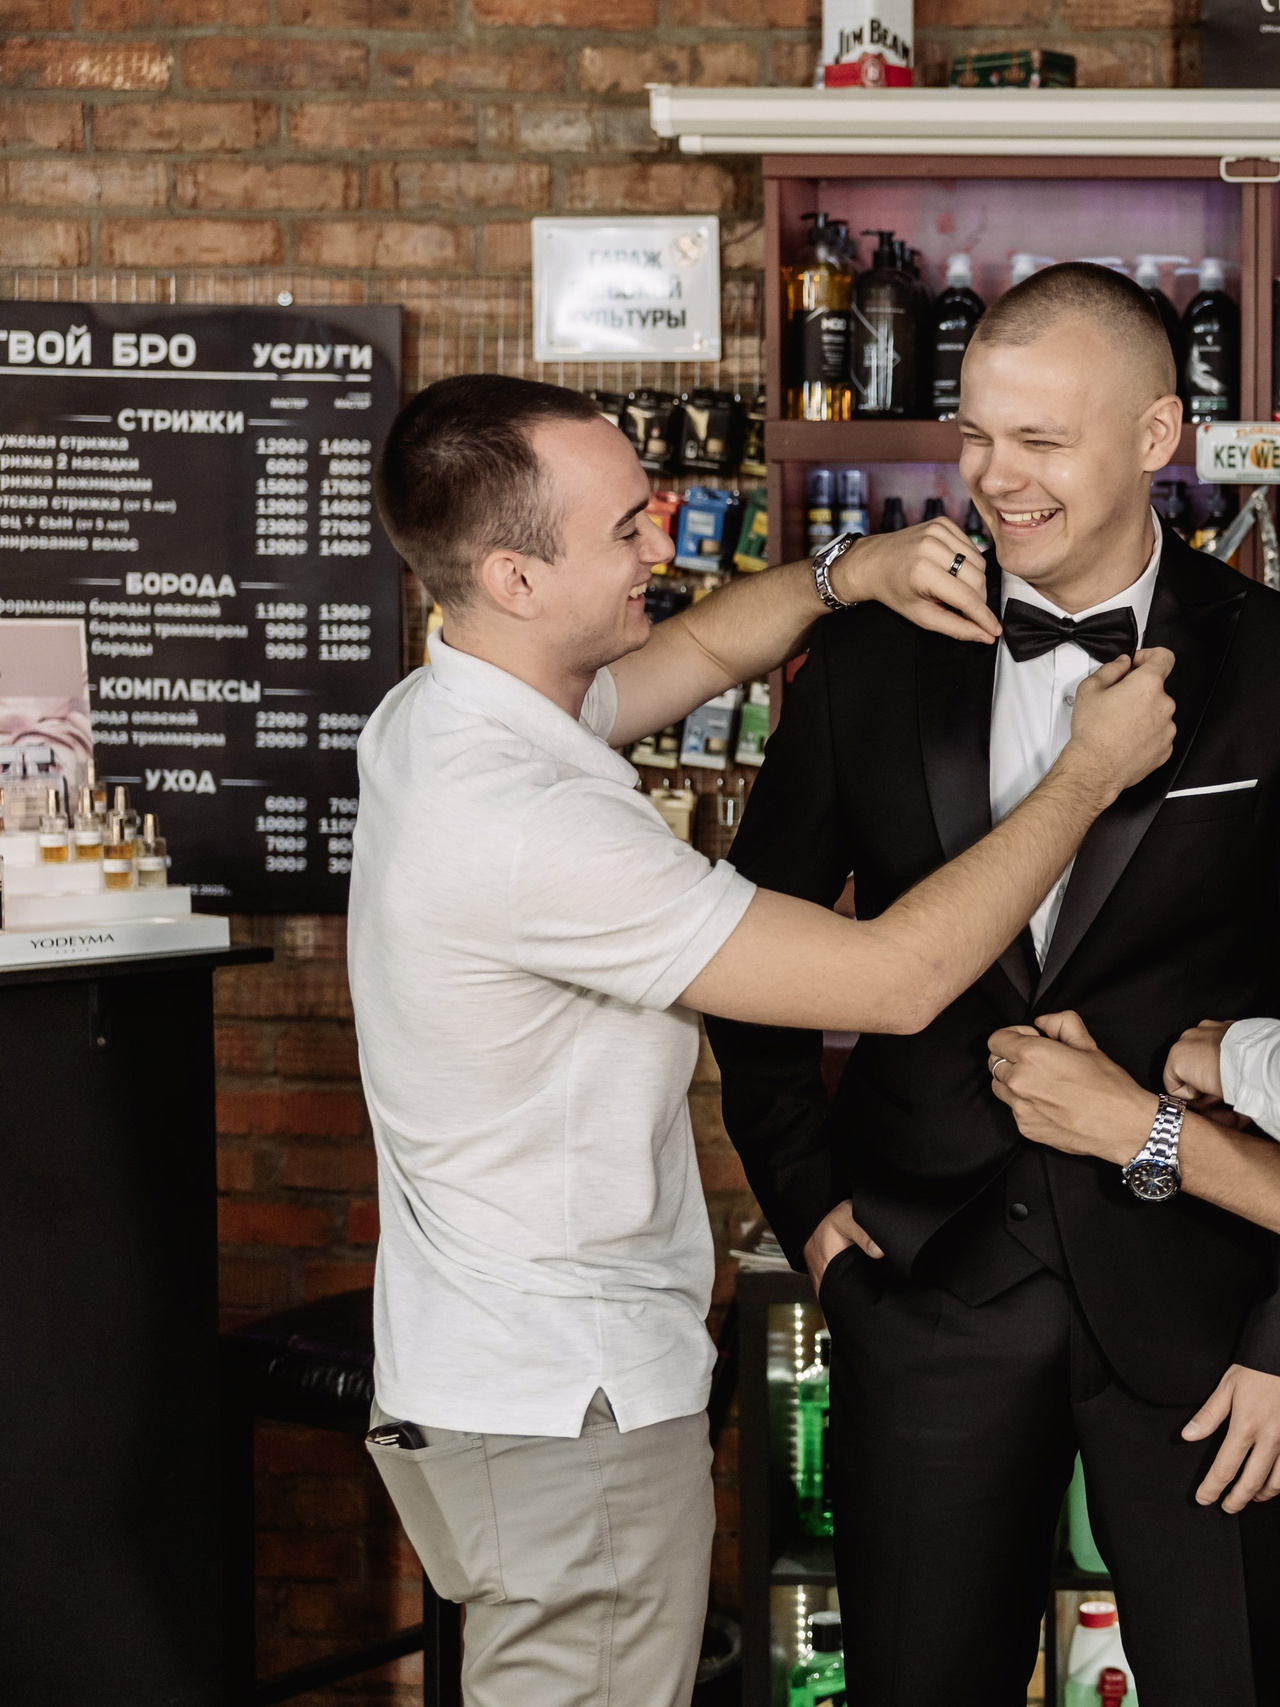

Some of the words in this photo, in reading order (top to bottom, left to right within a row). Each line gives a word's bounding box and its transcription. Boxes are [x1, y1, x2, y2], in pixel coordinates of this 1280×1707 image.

[589, 249, 662, 268] ГАРАЖ
[113, 333, 197, 368] БРО
[253, 343, 373, 370] УСЛУГИ
[117, 408, 245, 434] СТРИЖКИ
[59, 435, 129, 453] стрижка
[56, 453, 68, 469] 2
[71, 457, 139, 473] насадки
[1214, 445, 1249, 469] KEY
[56, 476, 153, 493] ножницами
[51, 496, 121, 513] стрижка
[39, 516, 74, 531] сын
[92, 538, 139, 552] волос
[126, 571, 237, 597] БОРОДА
[0, 599, 86, 617] ормление
[89, 598, 151, 618] бороды
[154, 600, 221, 618] опаской
[89, 618, 151, 638] бороды
[154, 622, 249, 641] триммером
[91, 637, 153, 657] бороды
[100, 676, 261, 703] КОМПЛЕКСЫ
[131, 709, 199, 727] опаской
[131, 731, 226, 749] триммером
[145, 769, 217, 794] УХОД
[30, 933, 115, 950] YODEYMA
